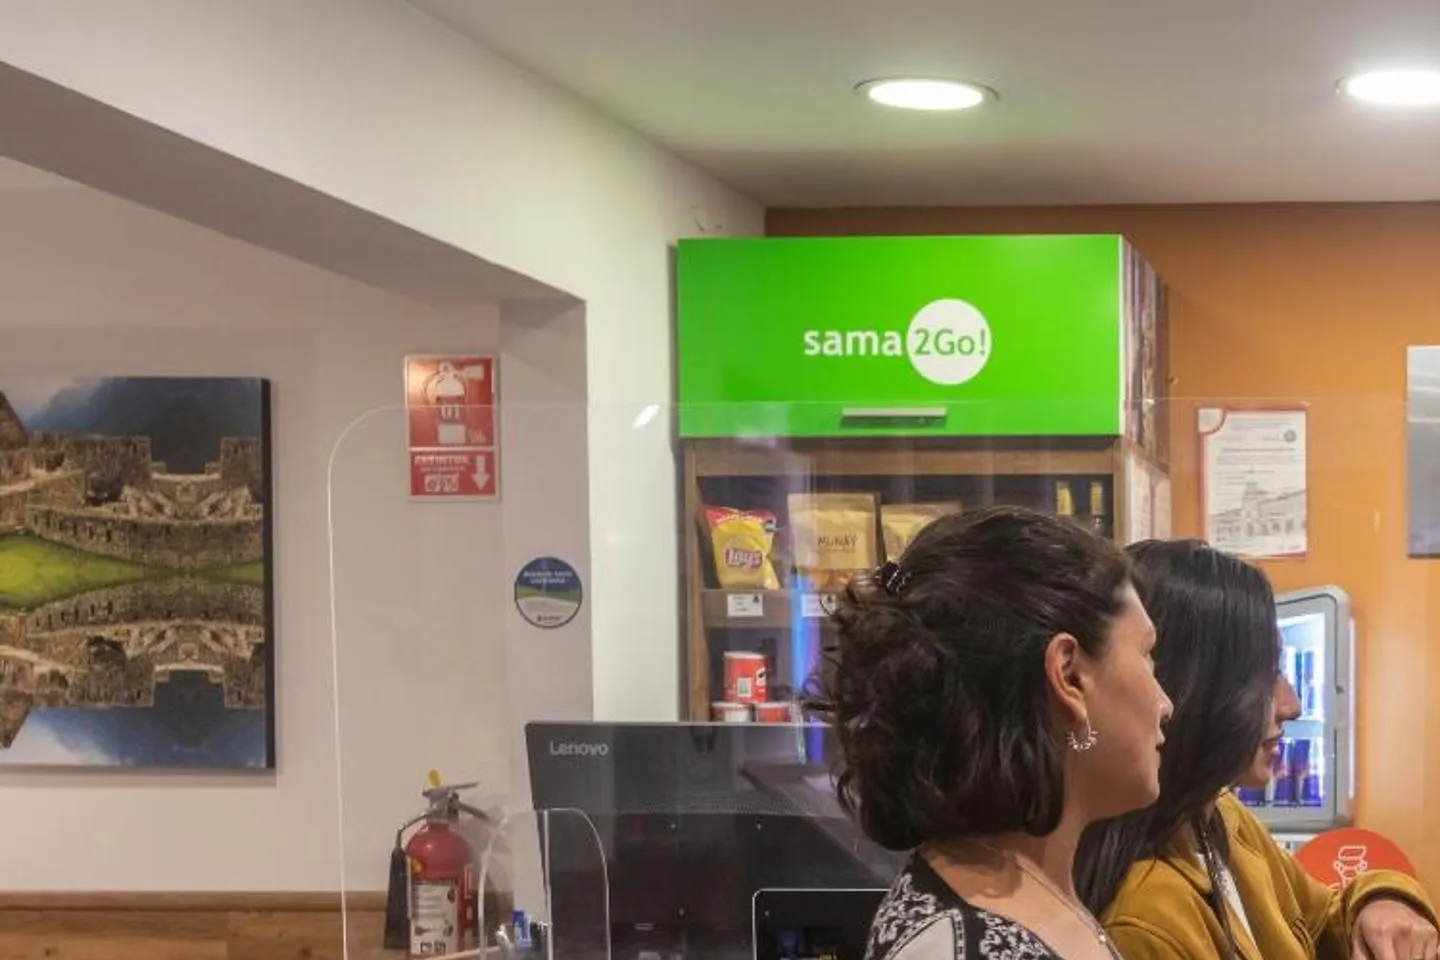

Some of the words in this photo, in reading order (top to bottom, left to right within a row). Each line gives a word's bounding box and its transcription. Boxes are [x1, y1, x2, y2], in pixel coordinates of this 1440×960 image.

[803, 330, 902, 357] sama
[914, 327, 986, 356] 2Go!
[549, 739, 610, 756] Lenovo
